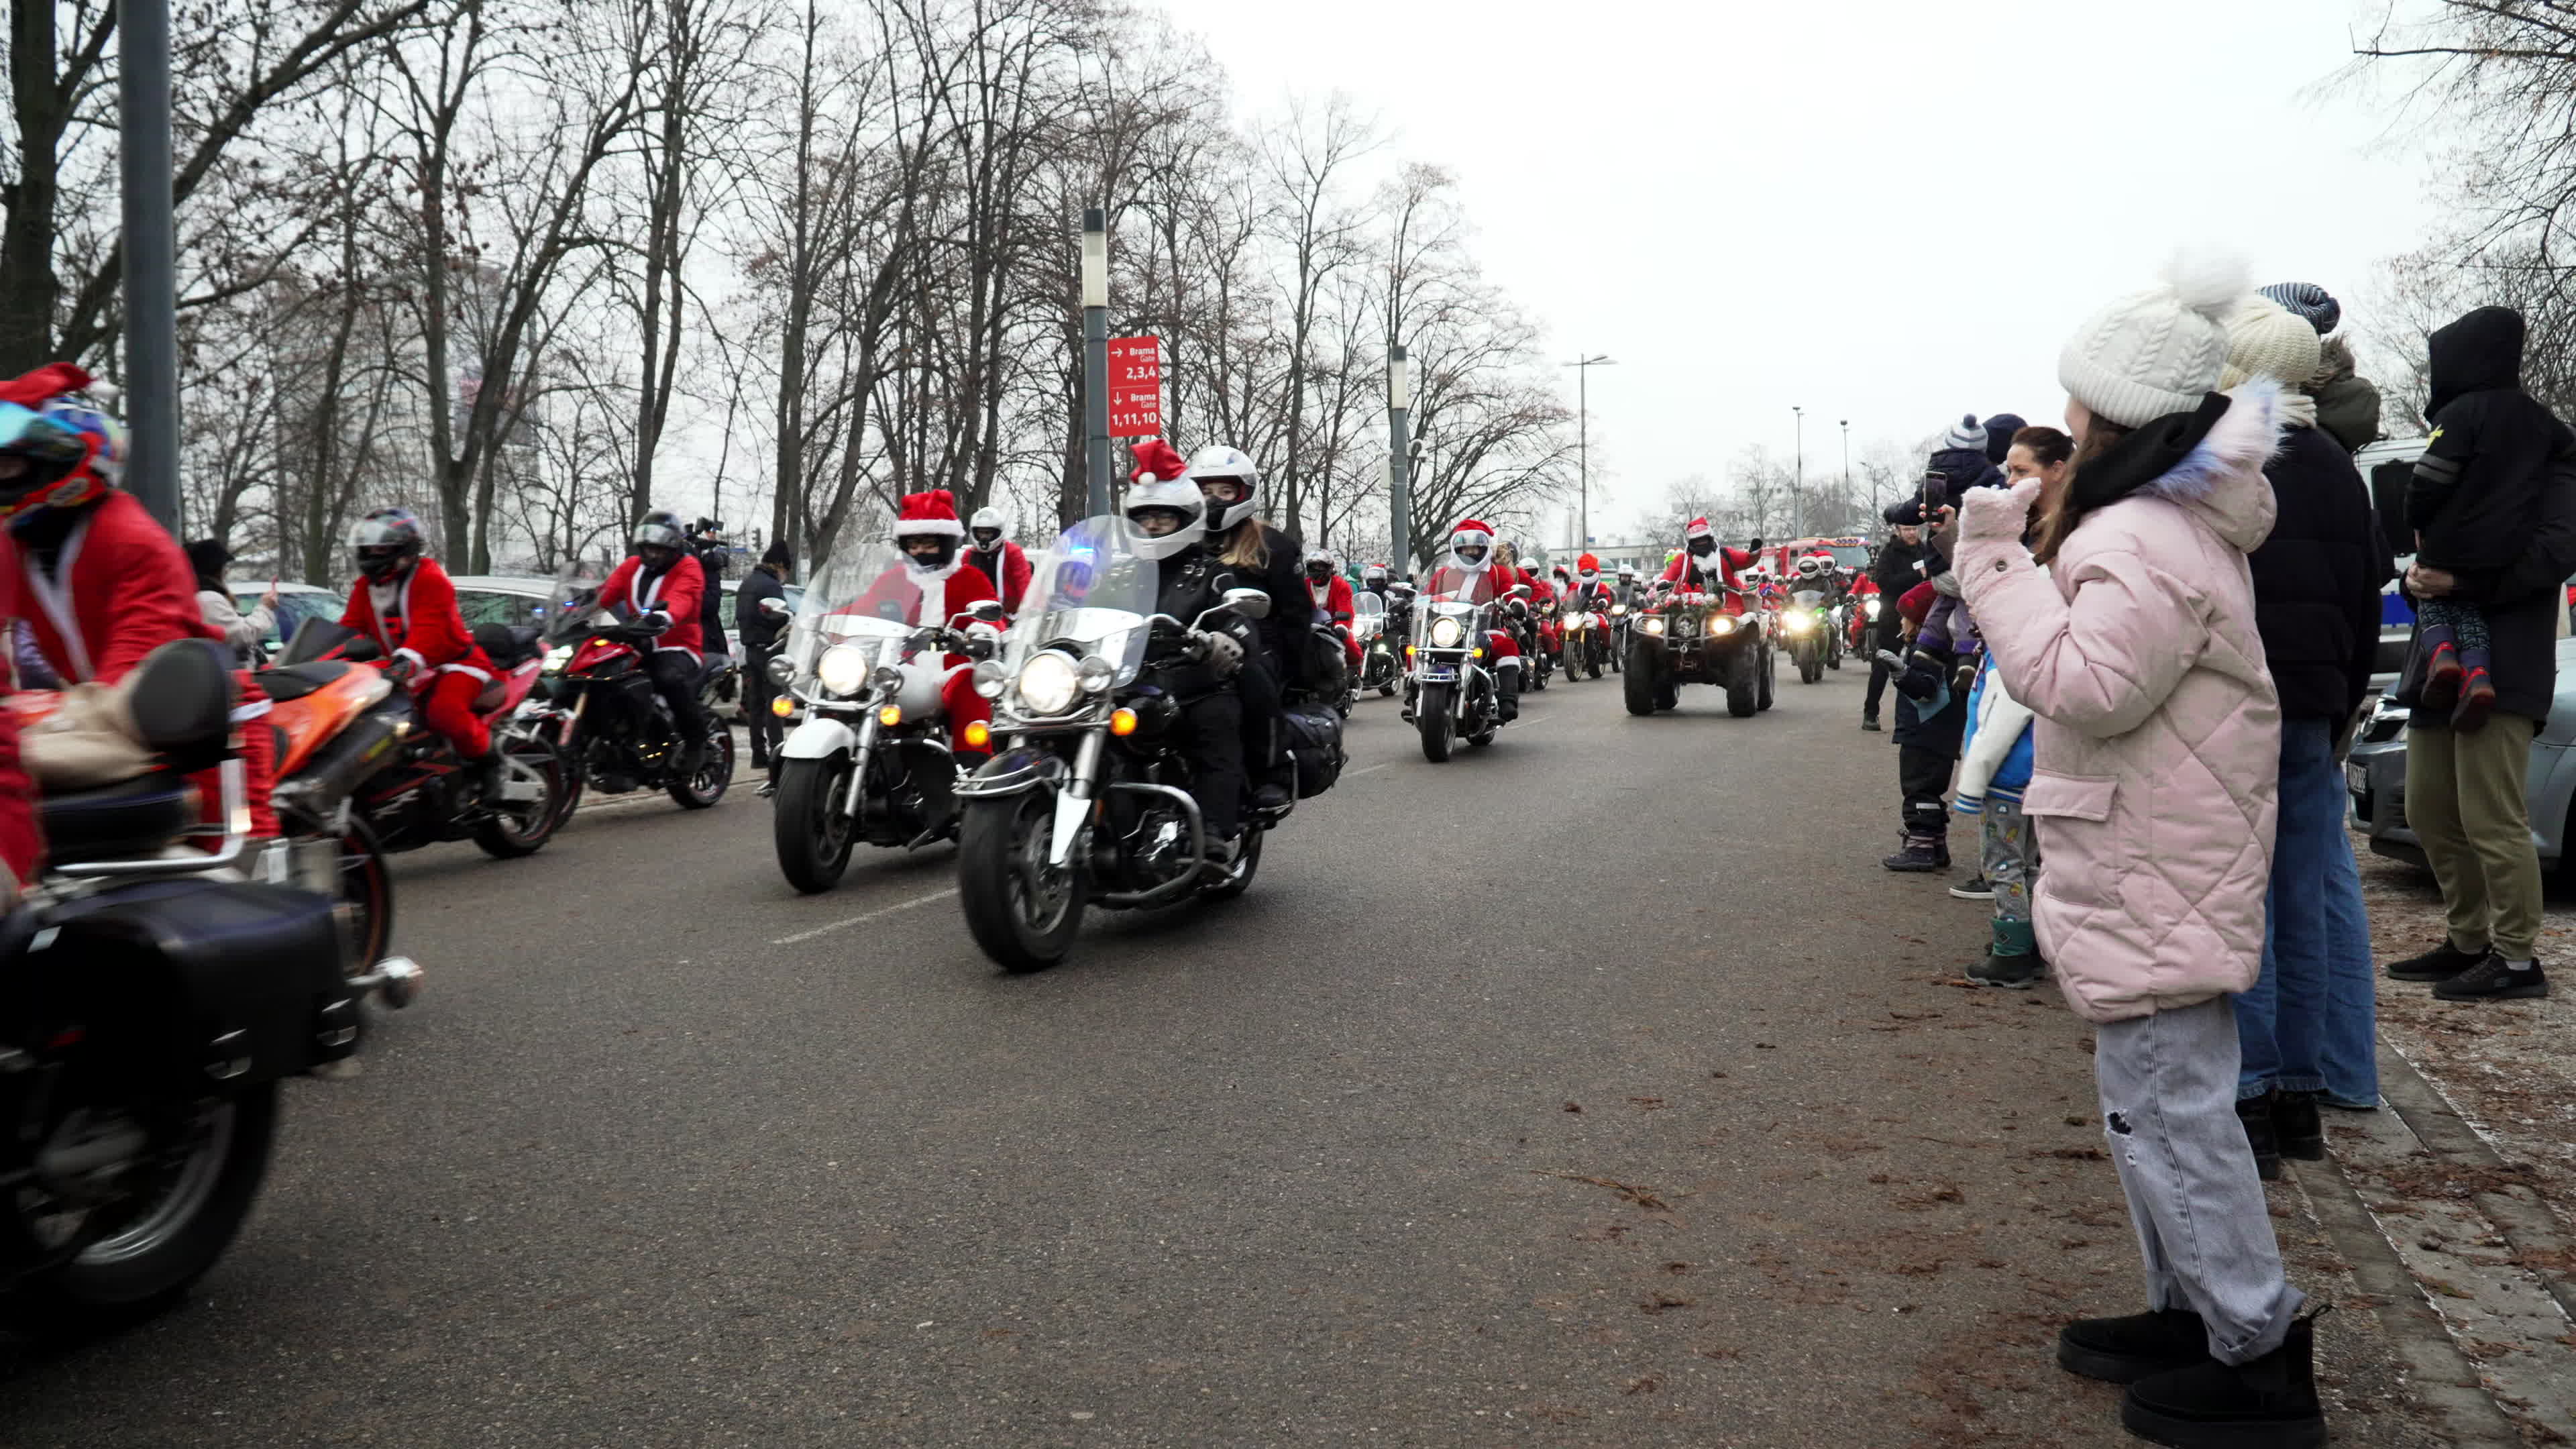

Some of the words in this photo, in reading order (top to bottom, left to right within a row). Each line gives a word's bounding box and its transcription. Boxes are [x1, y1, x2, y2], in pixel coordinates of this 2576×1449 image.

[1129, 347, 1155, 356] Brama
[1126, 365, 1156, 380] 2,3,4
[1130, 393, 1157, 402] Brama
